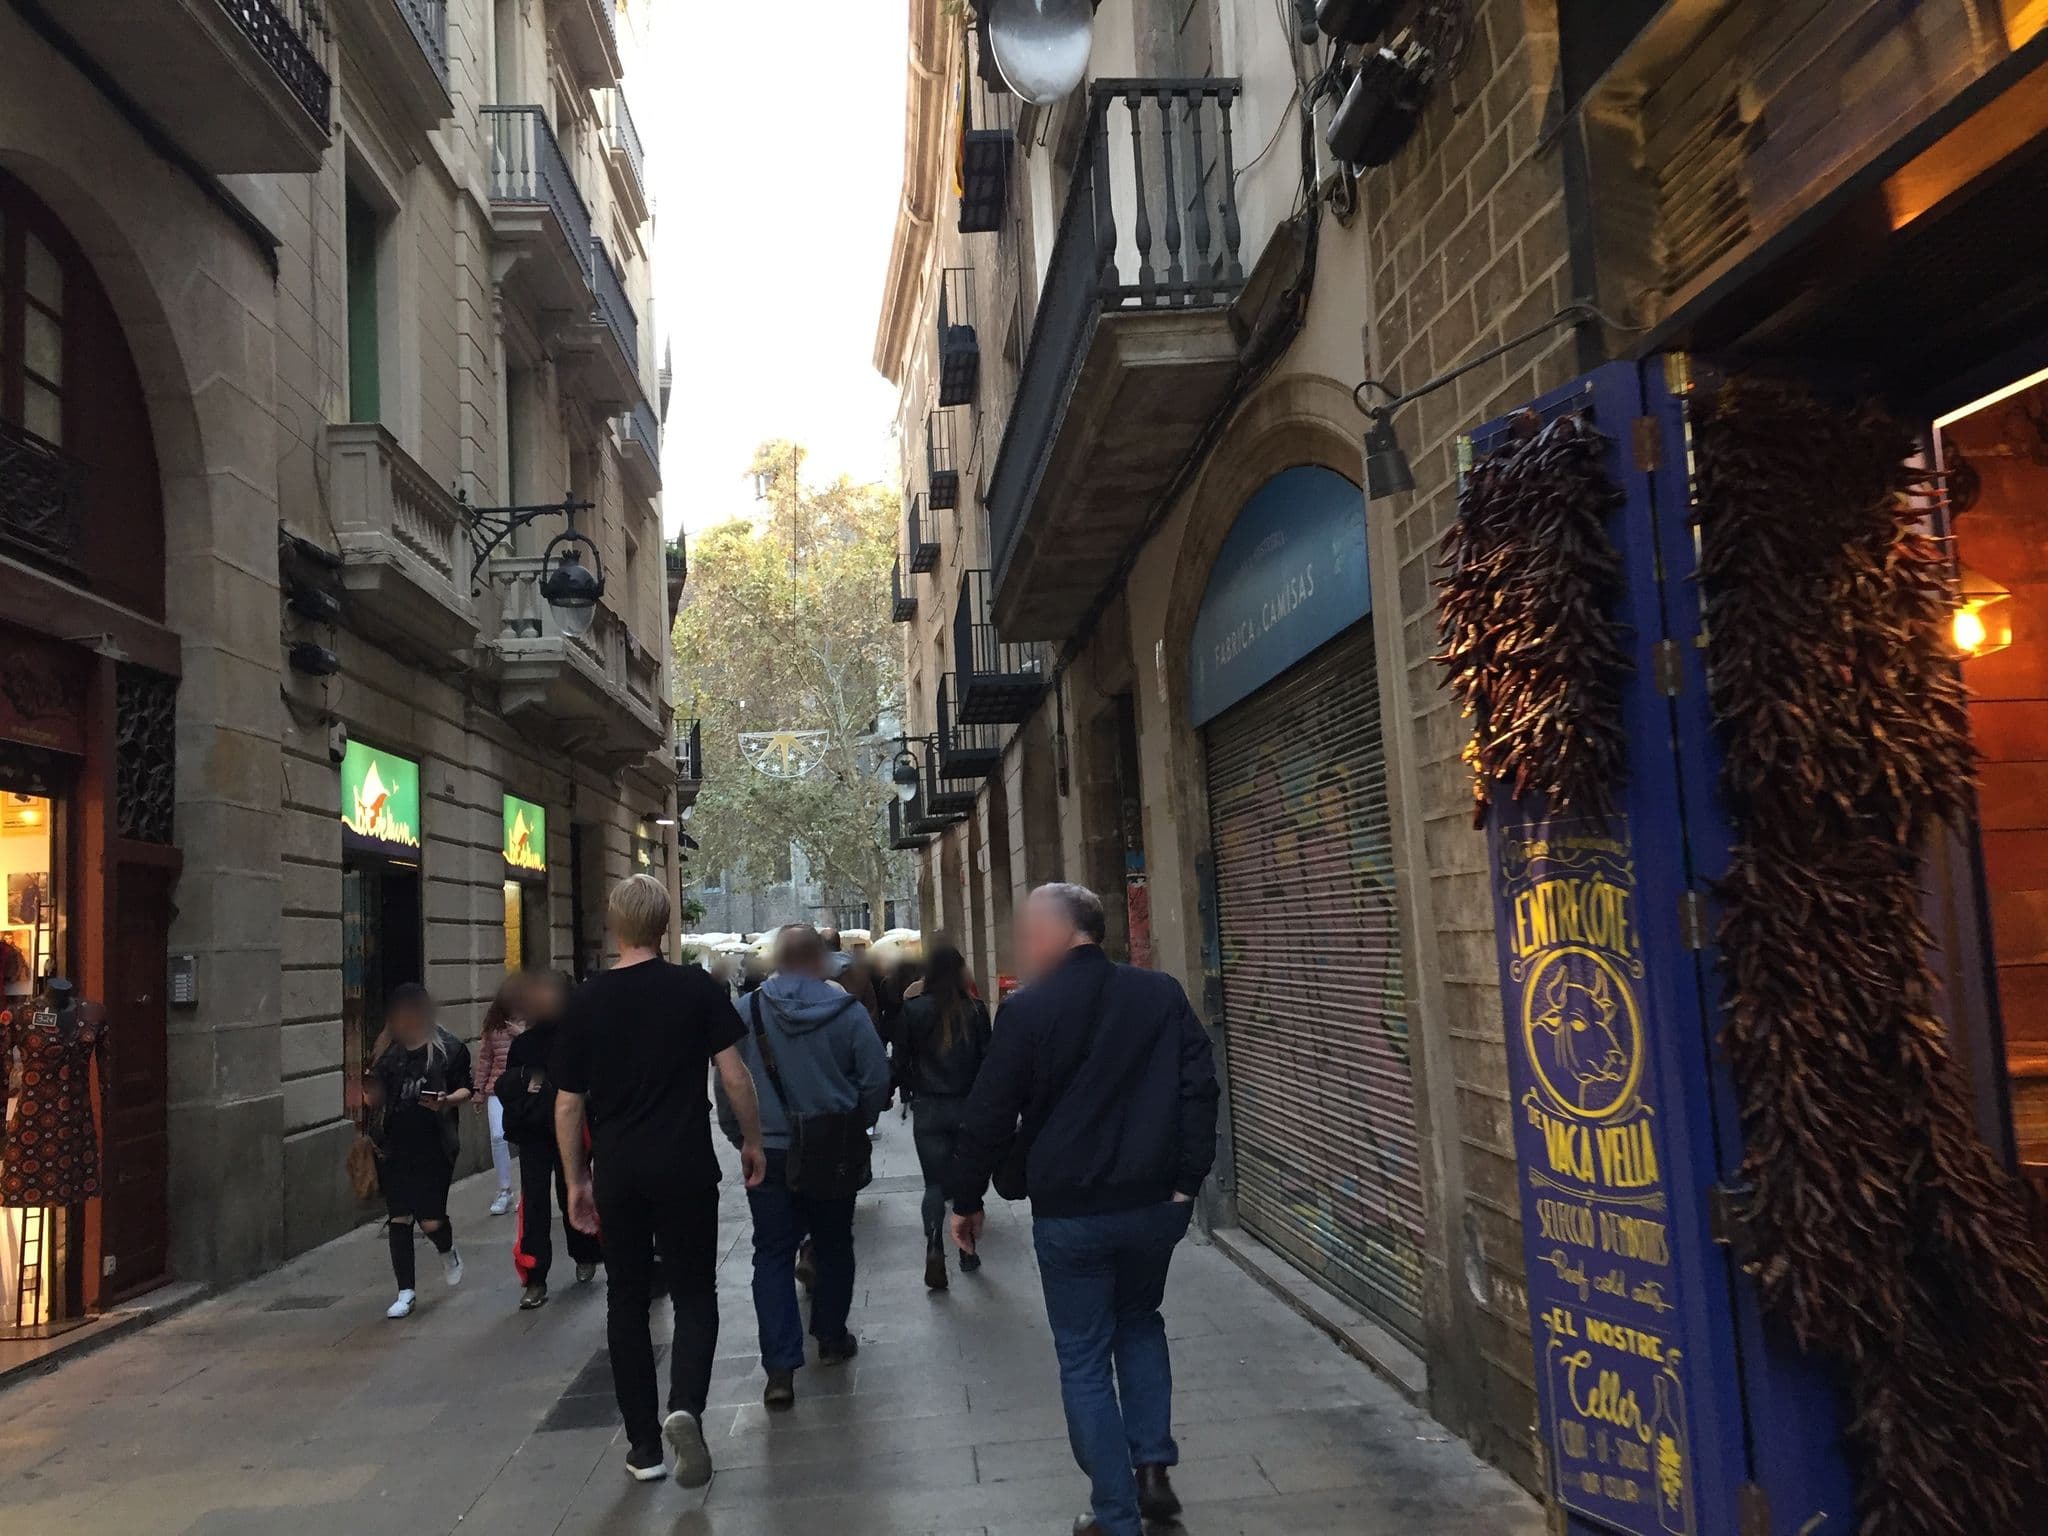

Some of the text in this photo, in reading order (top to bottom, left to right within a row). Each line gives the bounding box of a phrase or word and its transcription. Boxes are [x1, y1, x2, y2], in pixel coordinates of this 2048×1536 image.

[1262, 563, 1314, 632] CAMISAS
[1541, 1113, 1596, 1184] VACA
[1595, 1118, 1659, 1188] VELLA
[1552, 1306, 1665, 1363] EL NOSTRE
